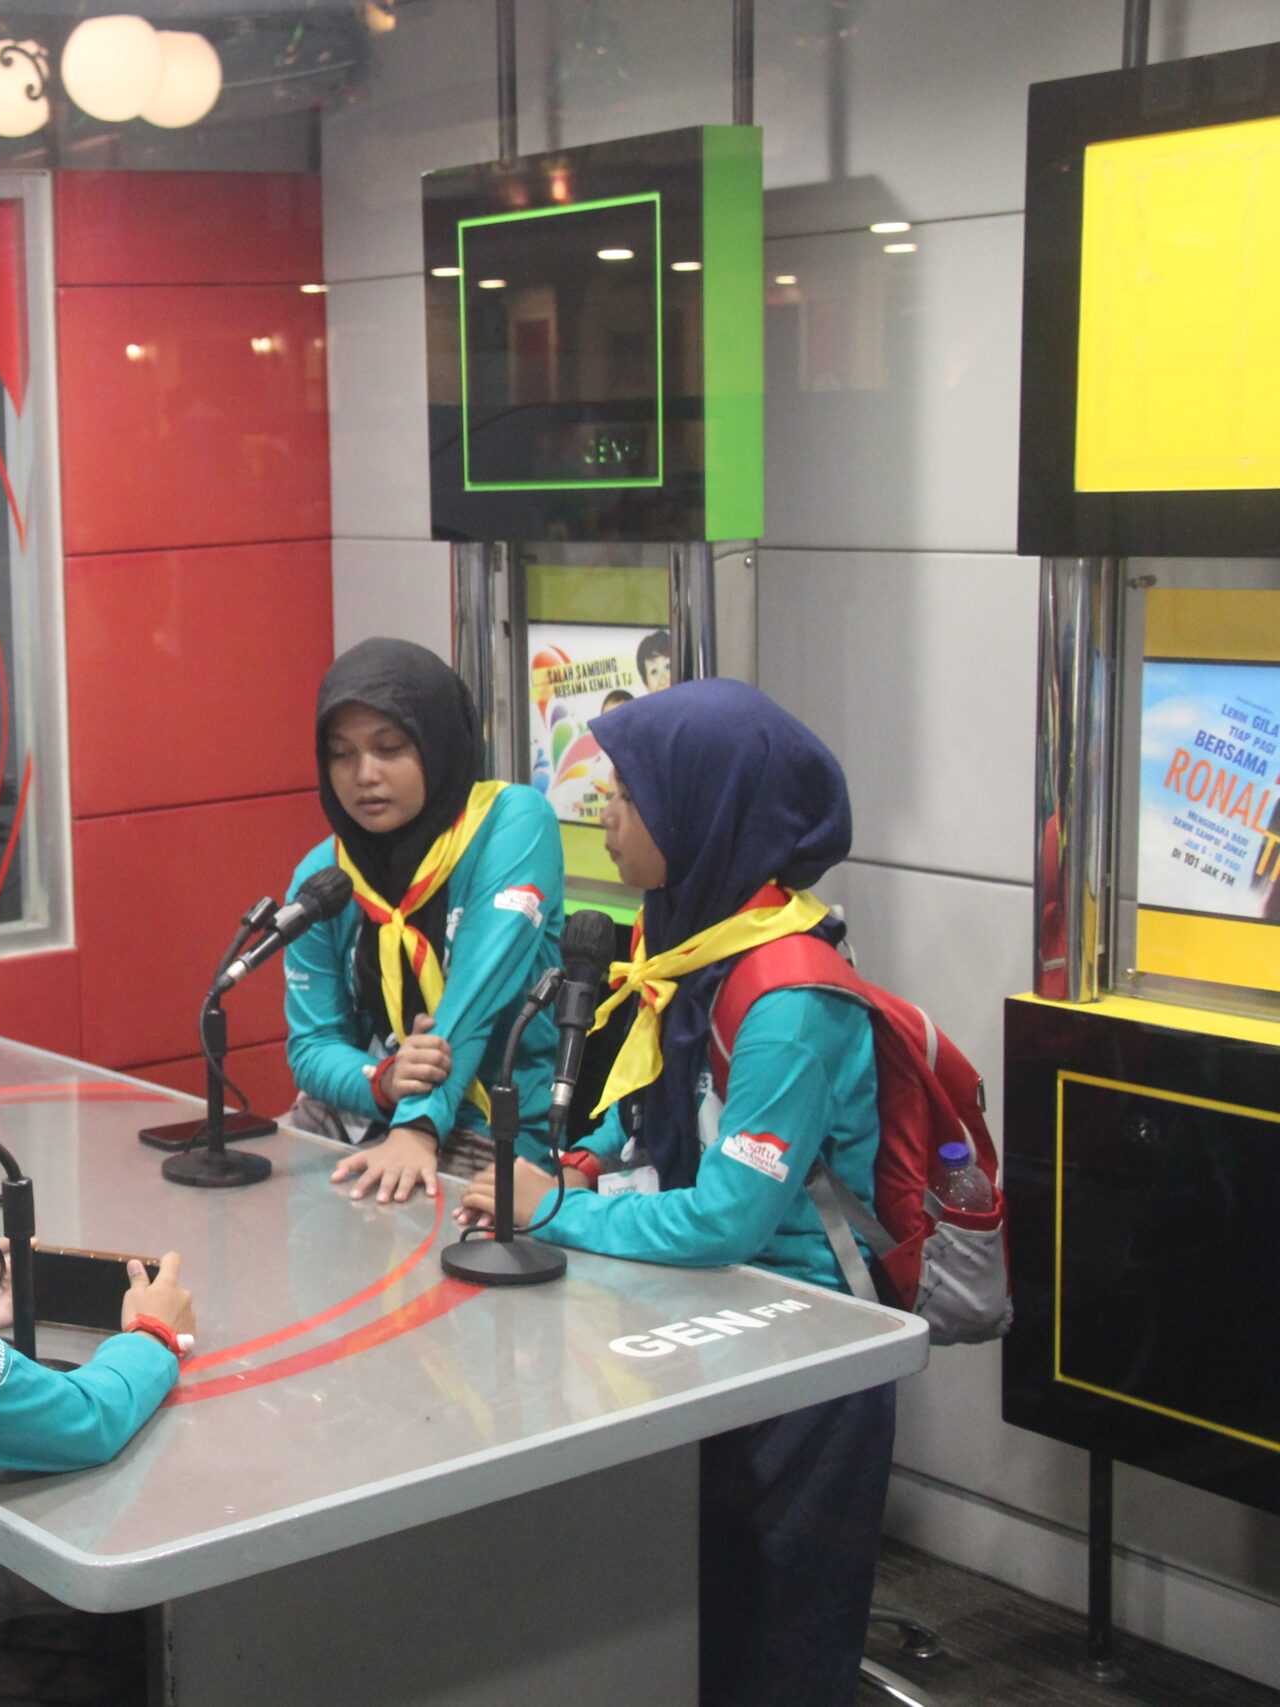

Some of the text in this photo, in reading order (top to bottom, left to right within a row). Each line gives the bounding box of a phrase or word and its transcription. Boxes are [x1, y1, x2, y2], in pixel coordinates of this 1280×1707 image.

[547, 657, 618, 685] SALAH SAMBUNG
[554, 682, 588, 698] BERSAMA
[589, 676, 613, 692] KEMAL
[1221, 704, 1249, 724] LEBIH
[1251, 715, 1280, 738] GILA
[1193, 729, 1268, 777] BERSAMA
[1228, 725, 1277, 755] TIAP PAGI
[1172, 847, 1236, 887] DI 101 JAK FM
[608, 1298, 813, 1357] GEN FM
